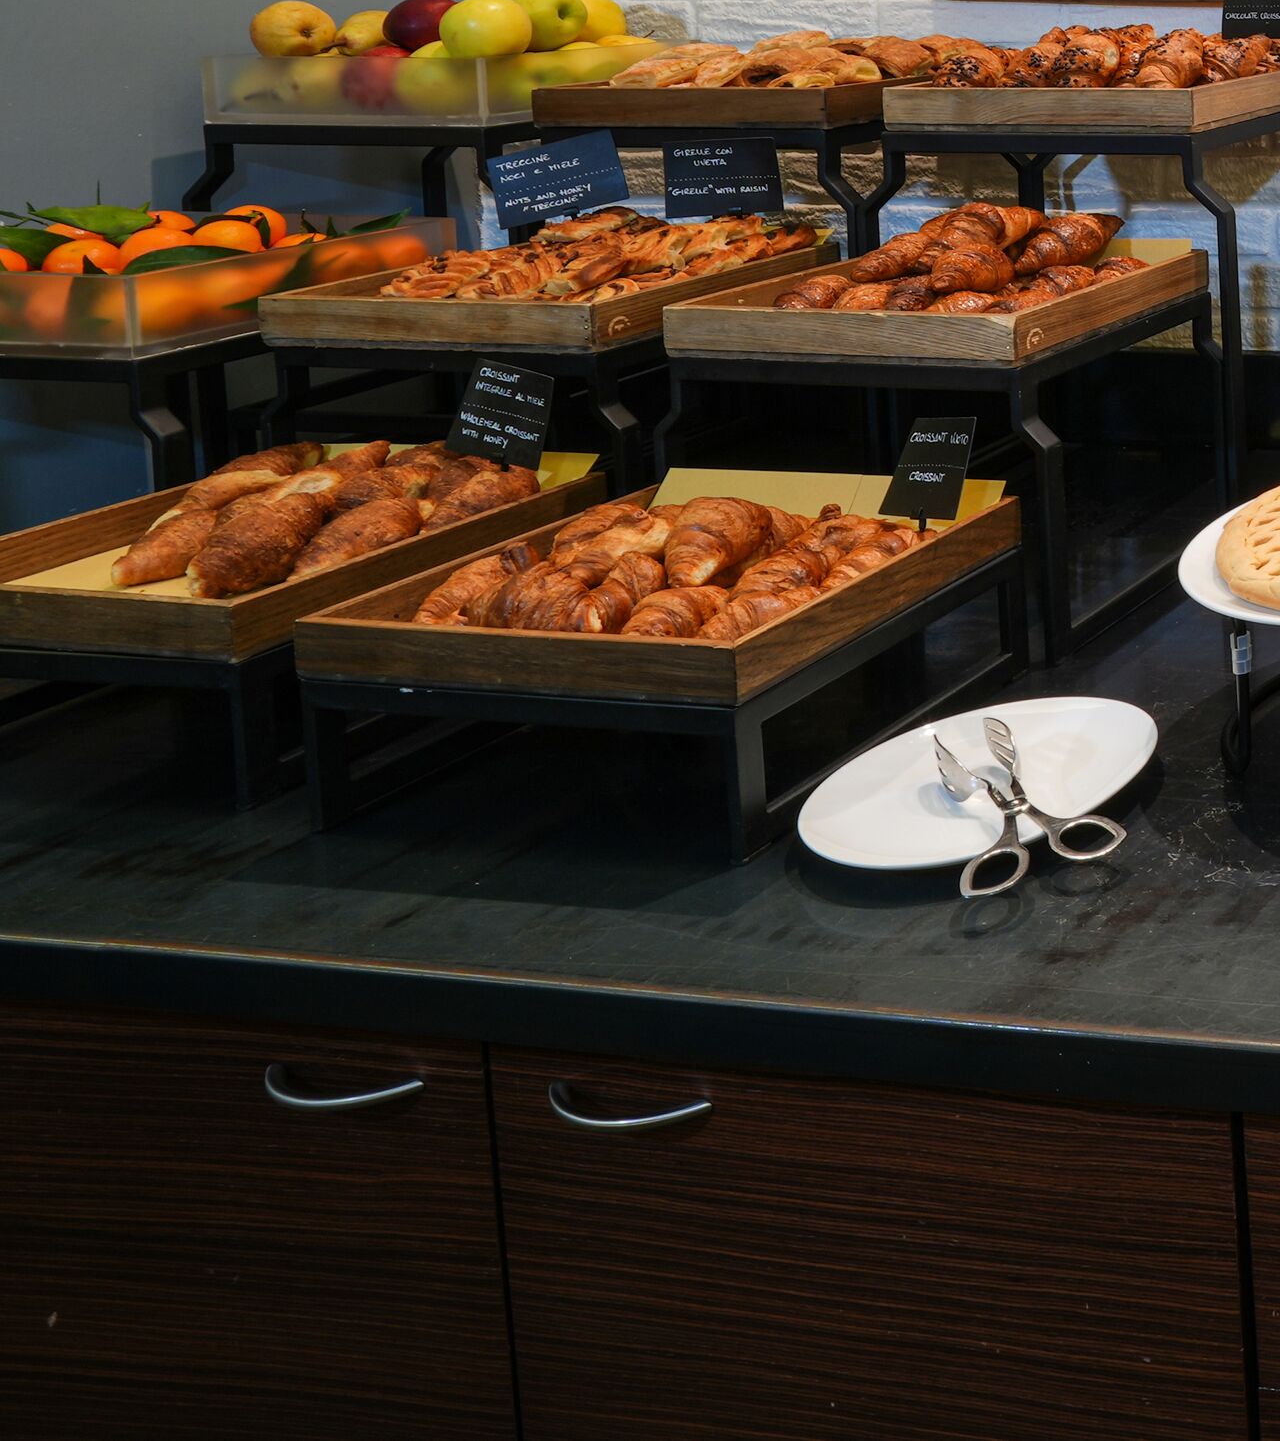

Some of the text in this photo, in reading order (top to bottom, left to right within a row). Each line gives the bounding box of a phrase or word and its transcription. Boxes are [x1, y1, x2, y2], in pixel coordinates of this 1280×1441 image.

[1225, 12, 1258, 20] CHOCOLATE
[673, 147, 733, 157] GIRELLE CON
[496, 153, 550, 171] TRECCINE
[500, 171, 526, 183] NOCI
[548, 158, 580, 171] MIELE
[505, 183, 591, 208] NUTS AND HONEY
[714, 186, 736, 194] WITH
[739, 184, 768, 193] RAISIN
[475, 381, 512, 398] INTEGRALE
[515, 392, 525, 401] AL
[461, 411, 540, 442] WHOLEMEAL CROISSANT
[462, 428, 509, 449] WITH HONEY
[909, 471, 946, 483] CROISSANT
